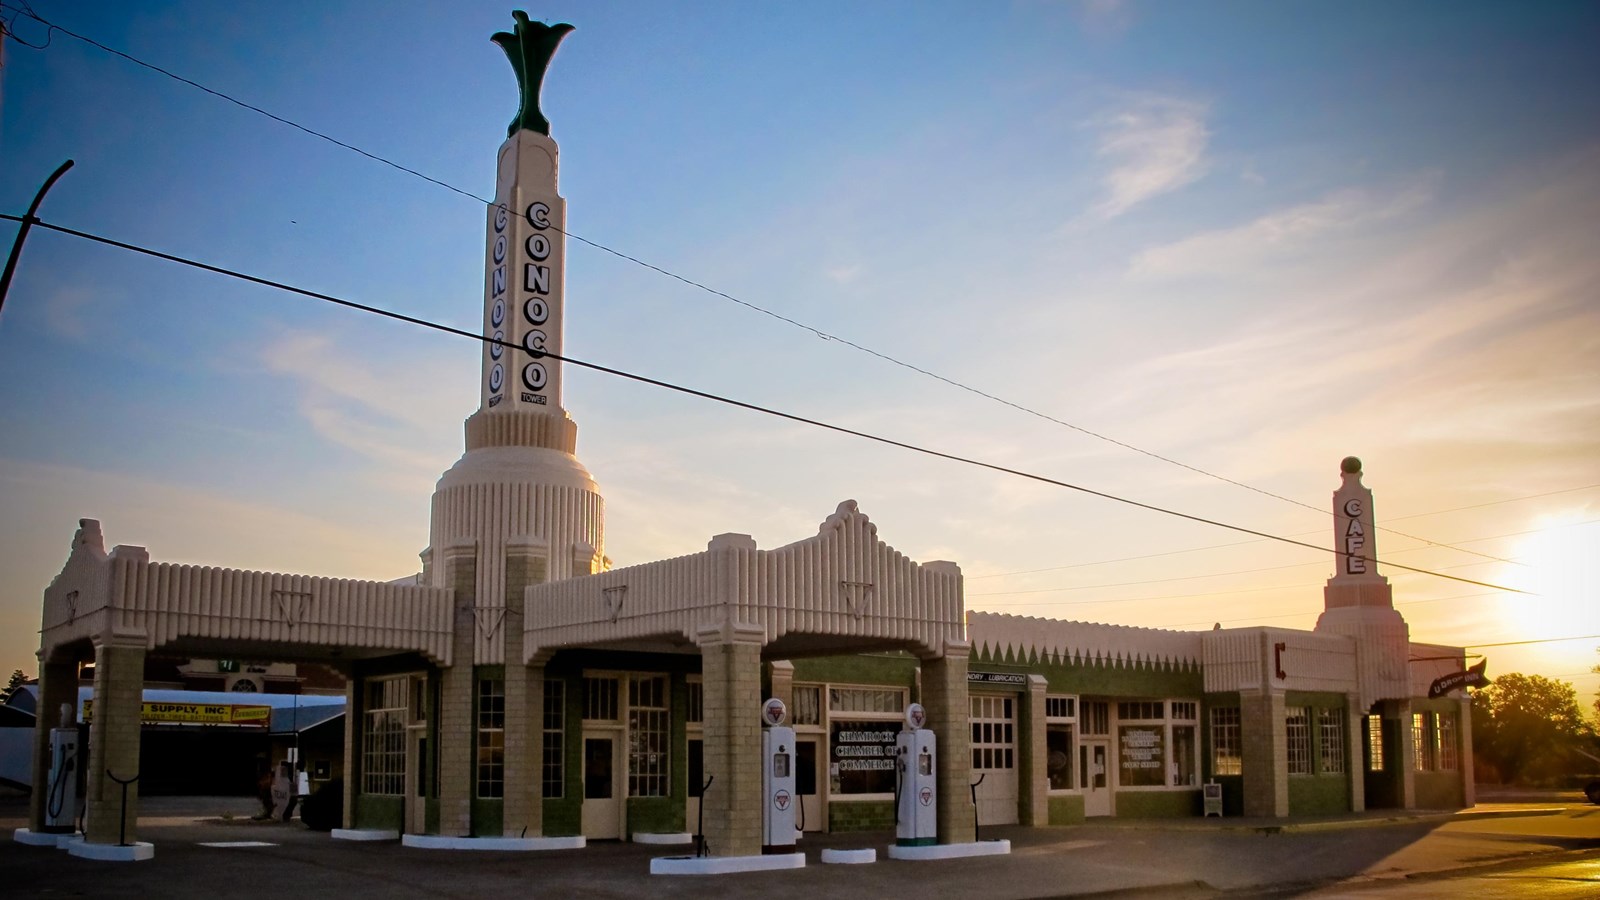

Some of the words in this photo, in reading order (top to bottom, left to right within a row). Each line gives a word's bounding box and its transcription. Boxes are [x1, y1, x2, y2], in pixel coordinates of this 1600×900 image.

[489, 203, 507, 394] CONOCO
[522, 202, 550, 392] CONOCO
[522, 393, 546, 405] TOWER
[1344, 499, 1366, 574] CAFE
[988, 674, 1024, 682] LUBRICATION
[151, 704, 198, 714] SUPPLY,
[205, 706, 229, 715] INC.
[839, 731, 895, 742] SHAMROCK
[835, 745, 884, 757] CHAMBER
[839, 759, 895, 770] COMMERCE
